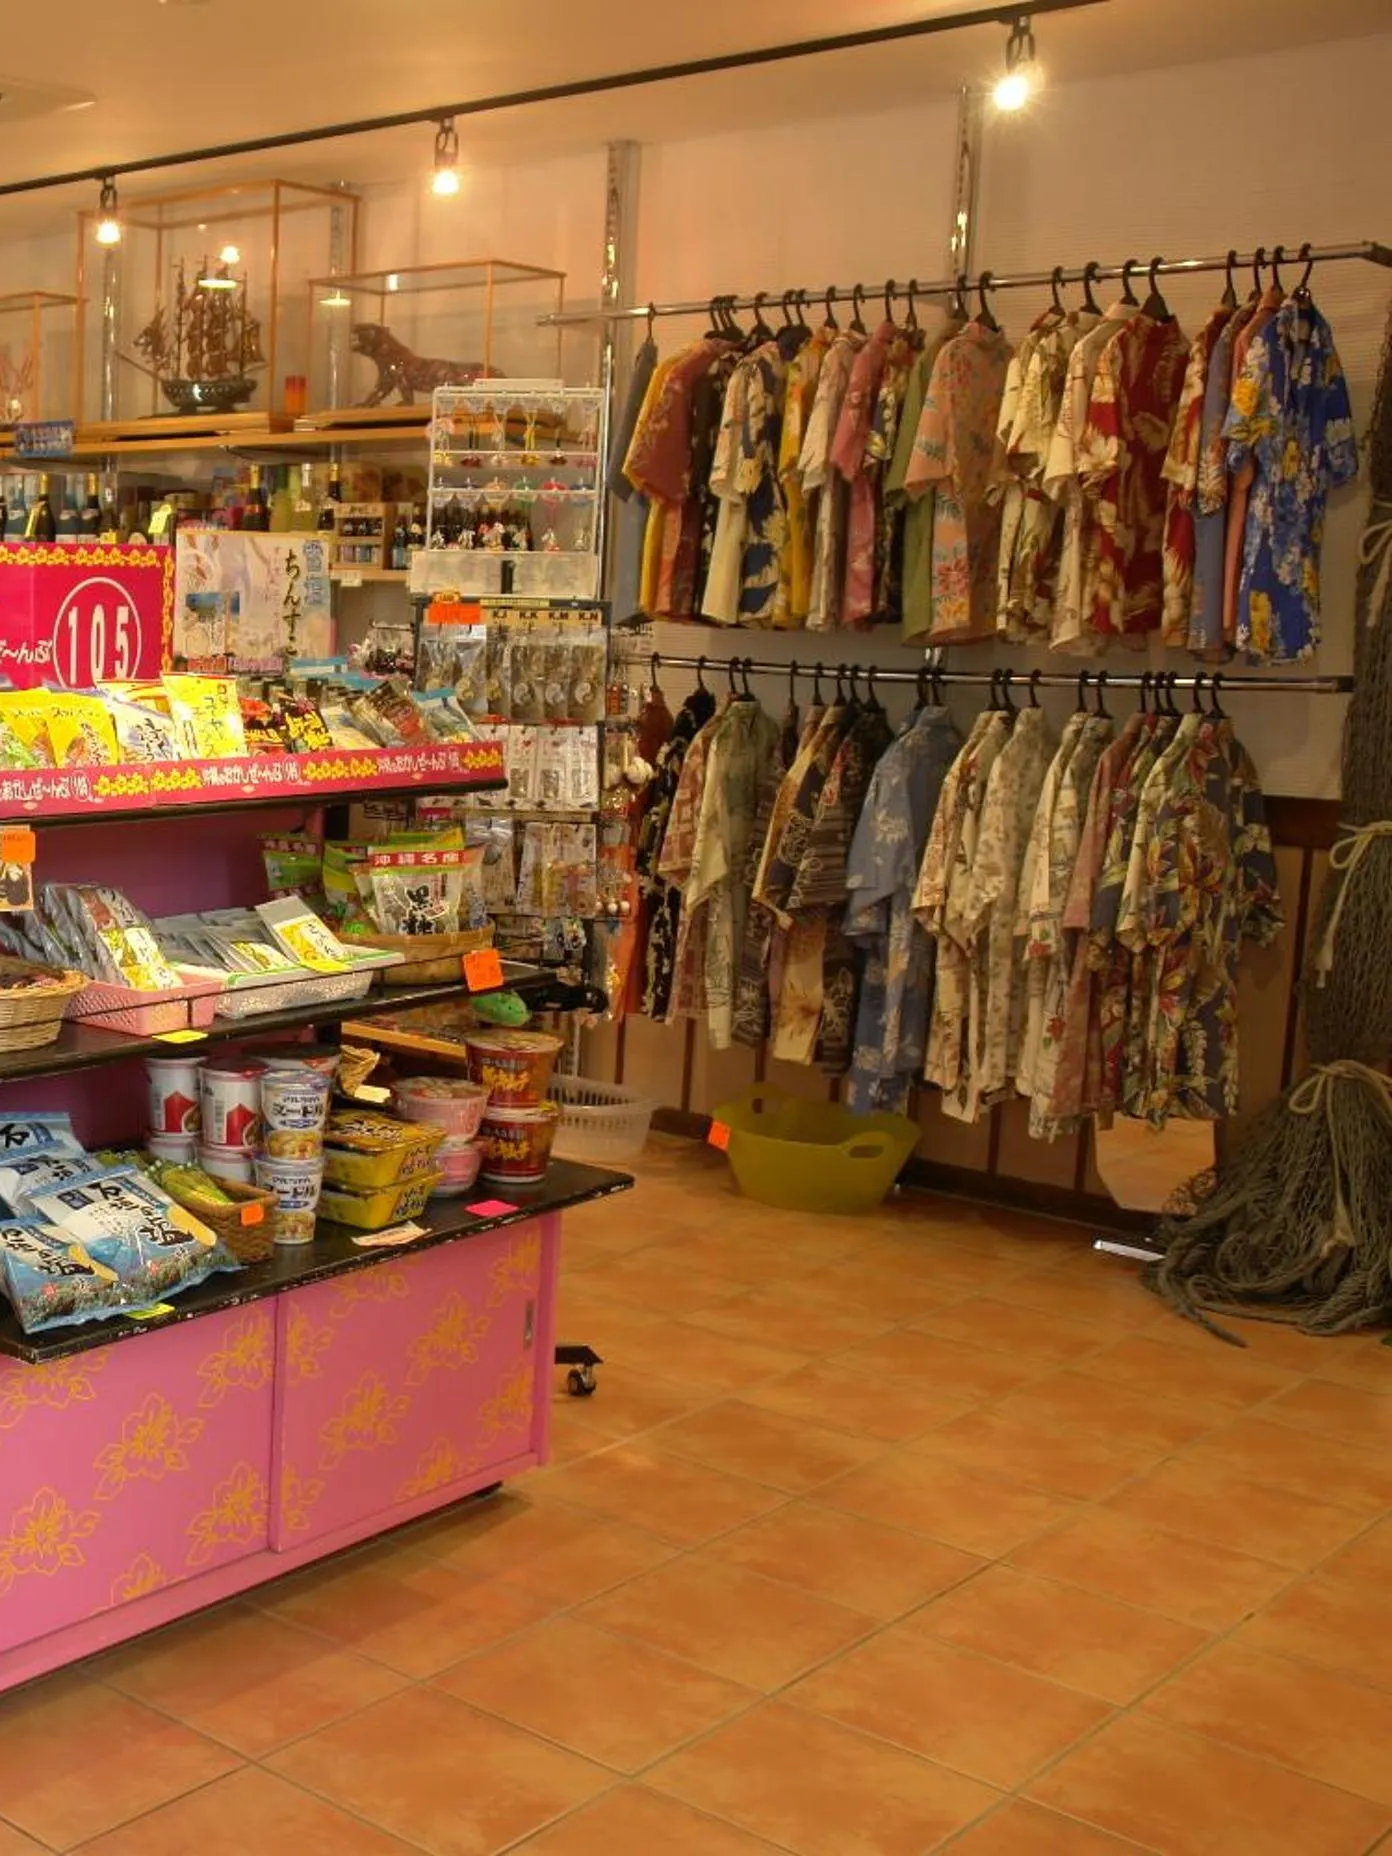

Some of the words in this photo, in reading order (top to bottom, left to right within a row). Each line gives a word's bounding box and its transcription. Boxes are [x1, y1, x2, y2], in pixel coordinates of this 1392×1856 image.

[68, 604, 129, 685] 105
[282, 548, 302, 656] ちんすこ
